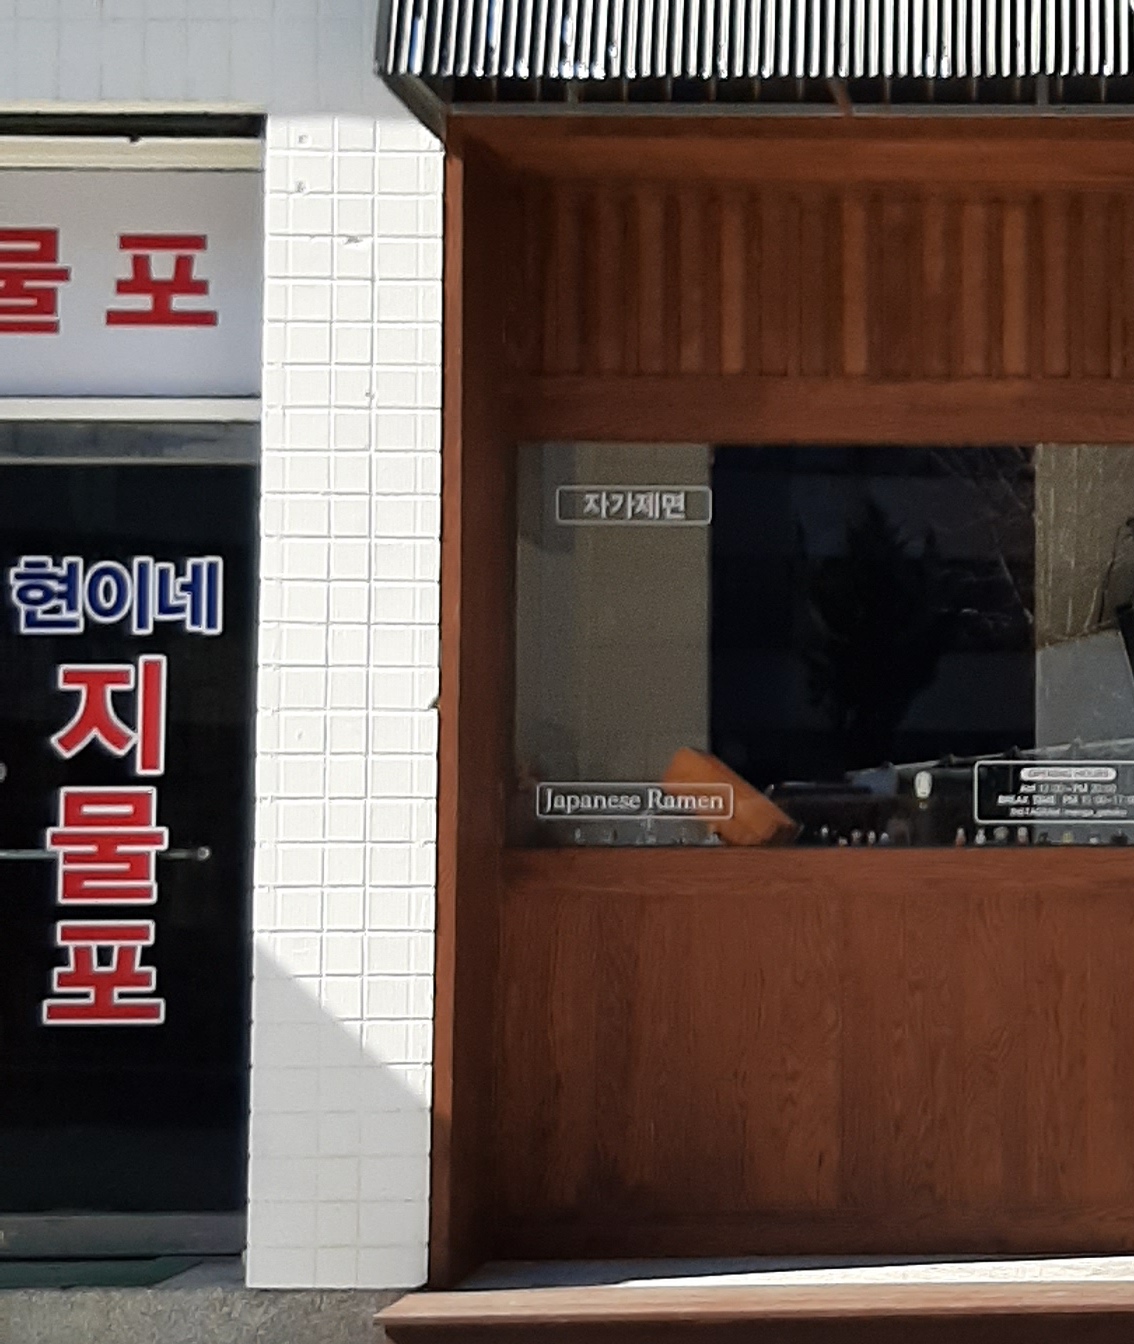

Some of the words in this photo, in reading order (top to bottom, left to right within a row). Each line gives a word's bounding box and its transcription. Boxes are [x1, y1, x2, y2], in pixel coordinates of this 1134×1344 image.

[583, 491, 686, 520] 자가제면
[11, 555, 224, 635] 현이네
[545, 787, 641, 815] Japanese
[646, 787, 724, 810] Ramen
[43, 654, 168, 1027] 지물포
